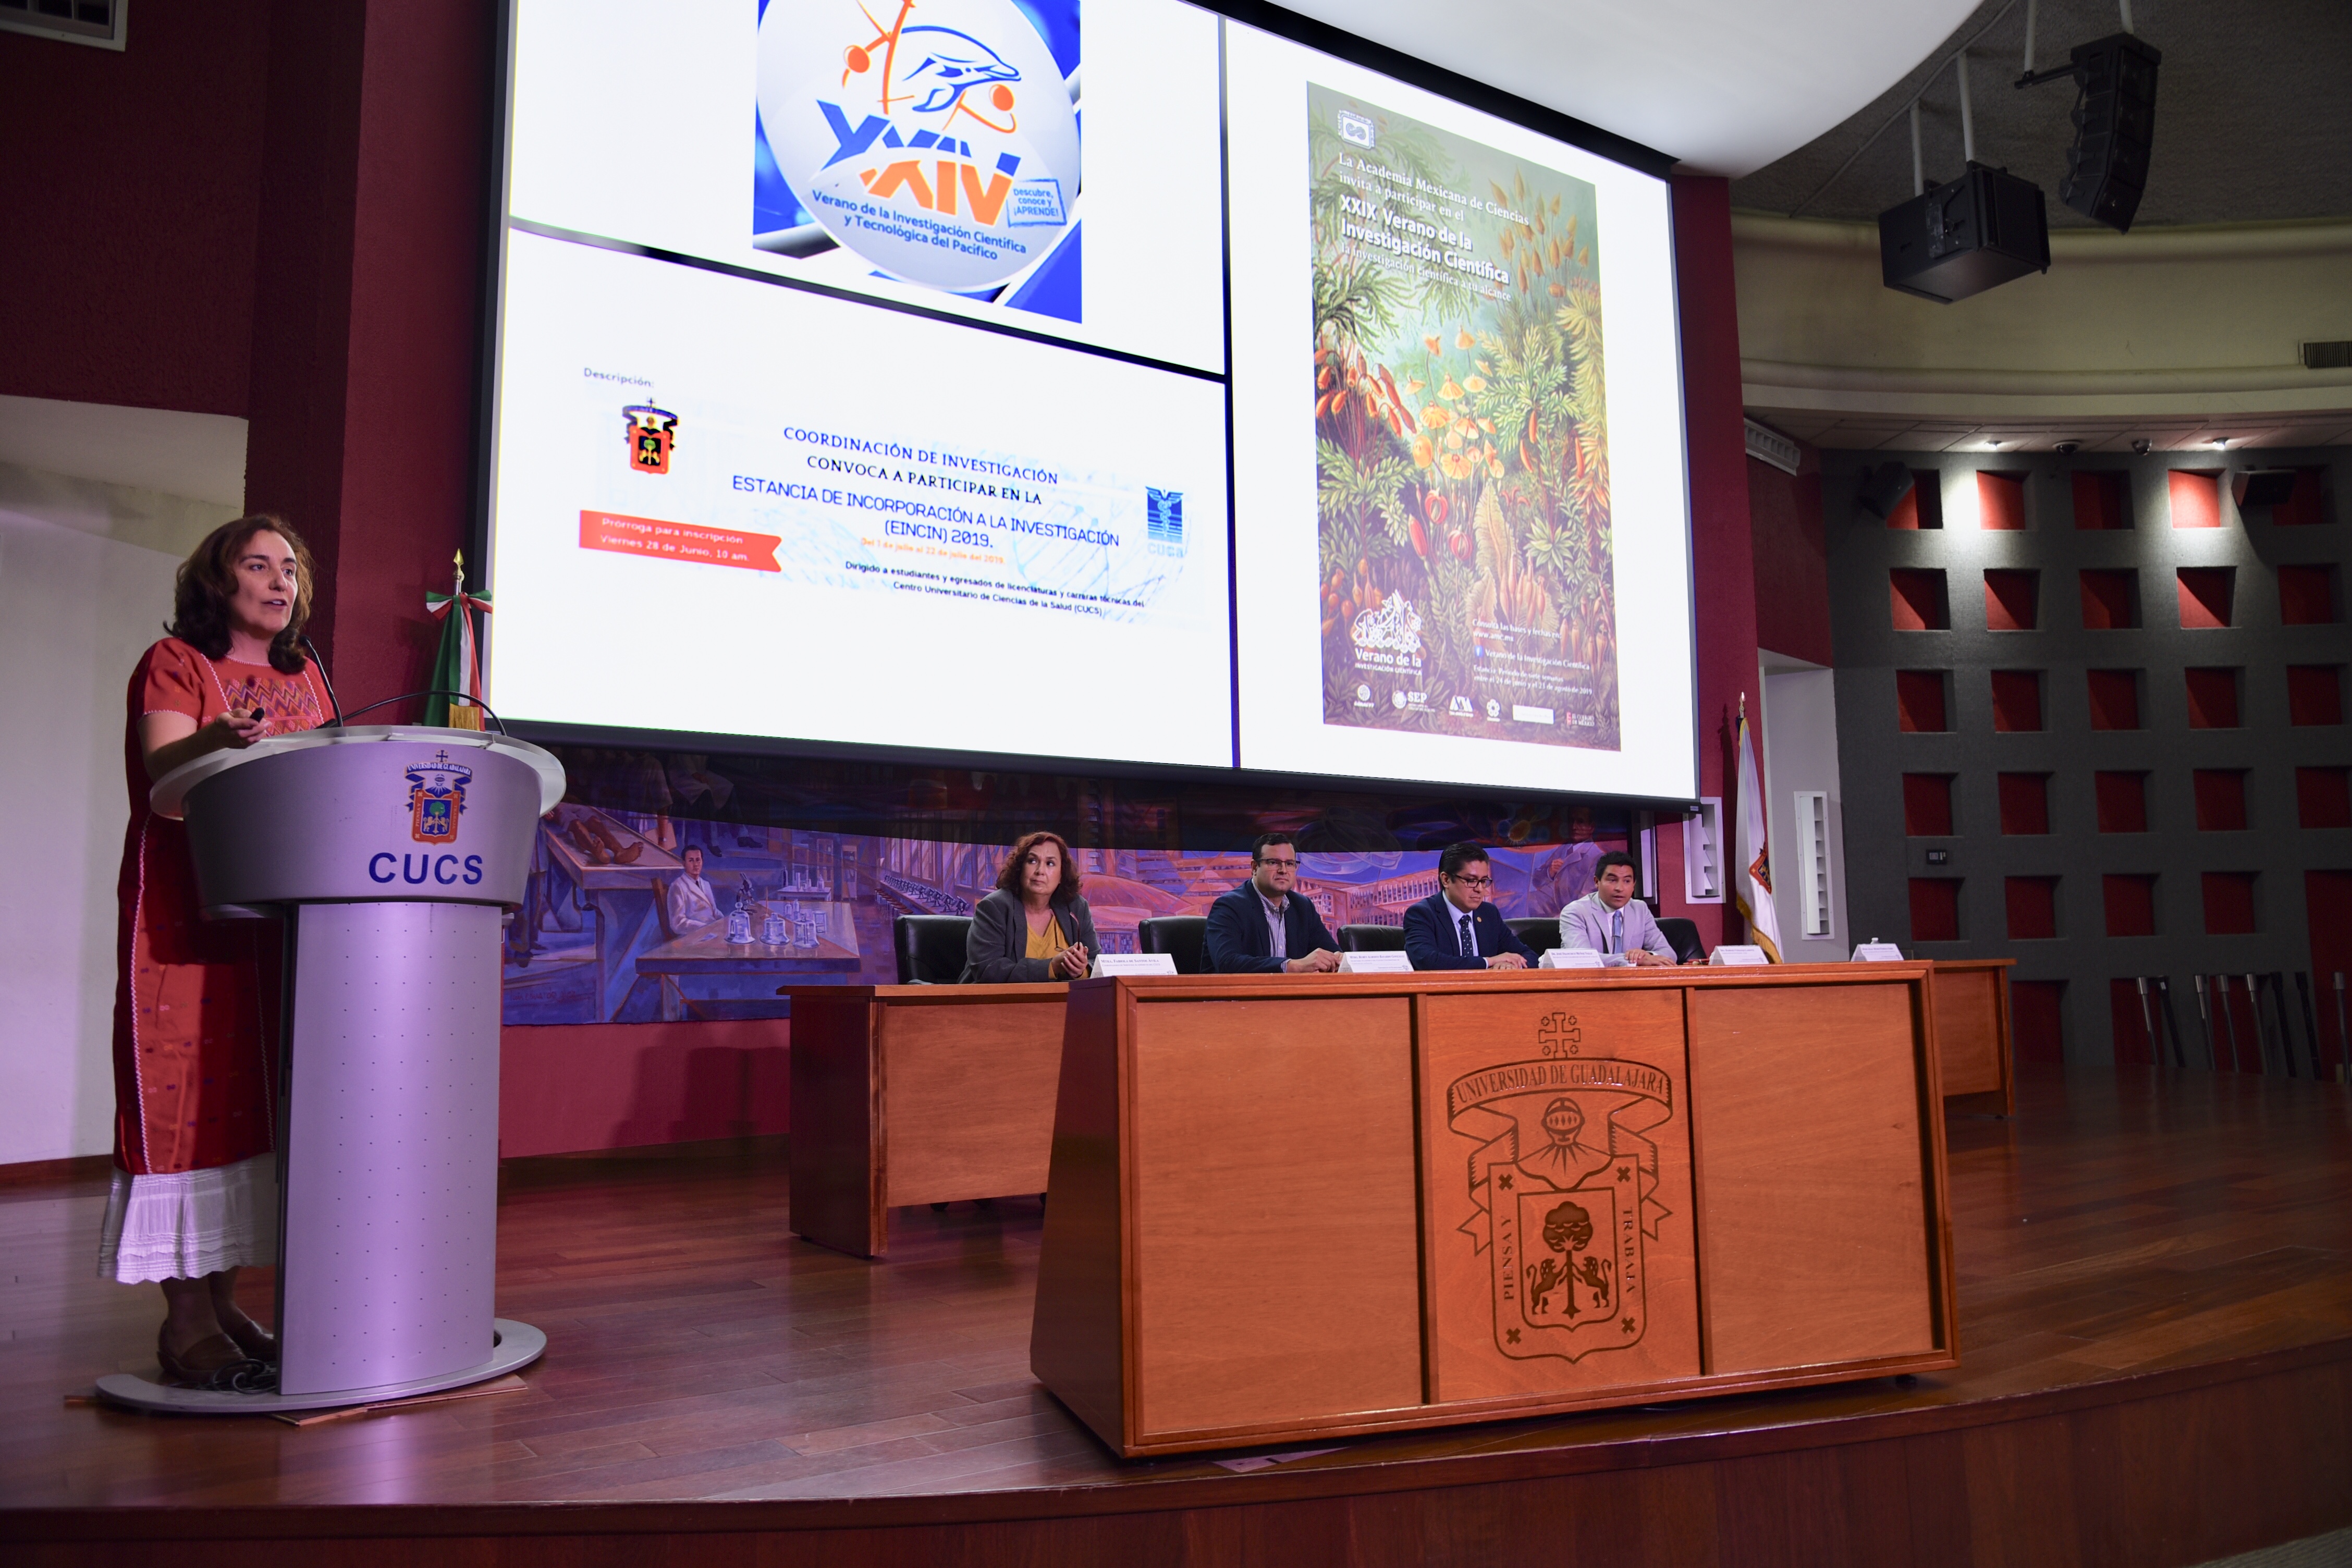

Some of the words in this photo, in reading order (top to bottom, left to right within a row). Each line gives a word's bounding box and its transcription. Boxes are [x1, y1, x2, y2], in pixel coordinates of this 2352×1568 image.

[1013, 189, 1054, 198] Descubre,
[1339, 152, 1353, 168] La
[1357, 159, 1413, 187] Academia
[1416, 178, 1467, 205] Mexicana
[1470, 197, 1483, 210] de
[1486, 201, 1529, 226] Ciencias
[1340, 171, 1372, 191] invita
[1375, 185, 1381, 194] a
[1385, 188, 1437, 212] participar
[1439, 206, 1452, 217] en
[1455, 210, 1464, 221] el
[812, 189, 858, 211] Verano
[861, 203, 876, 215] de
[879, 206, 890, 219] la
[893, 210, 971, 240] Investigación
[974, 231, 1026, 254] Científica
[1014, 206, 1059, 216] ¡APRENDE!
[1340, 194, 1377, 221] XXIX
[1382, 208, 1436, 239] Verano
[1438, 226, 1457, 246] de
[1460, 231, 1472, 251] la
[844, 215, 852, 227] y
[855, 215, 928, 243] Tecnológica
[931, 234, 949, 248] del
[1341, 218, 1441, 263] Investigación
[1444, 250, 1510, 284] Científica
[1341, 242, 1350, 254] la
[1353, 245, 1415, 273] investigación
[1417, 266, 1459, 286] científica
[1468, 281, 1478, 291] tu
[1480, 285, 1512, 302] alcance
[584, 368, 654, 388] Descripción:
[784, 427, 912, 460] COORDINACIÓN
[918, 449, 937, 464] DE
[942, 454, 1058, 484] INVESTIGACIÓN
[807, 456, 888, 480] CONVOCA
[893, 470, 903, 482] A
[908, 472, 997, 497] PARTICIPAR
[1002, 487, 1020, 501] EN
[1025, 491, 1042, 505] LA
[733, 475, 818, 501] ESTANCIA
[823, 489, 843, 505] DE
[847, 493, 973, 524] INCORPORACIÓN
[976, 513, 986, 527] A
[990, 515, 1007, 530] LA
[1011, 518, 1119, 547] INVESTIGACIÓN
[601, 534, 643, 548] Viernes
[646, 541, 659, 550] 28
[662, 543, 676, 552] de
[680, 545, 713, 558] Junio,
[716, 549, 728, 558] 10
[655, 526, 680, 536] para
[683, 529, 743, 544] inscripción
[861, 537, 875, 546] Del
[885, 520, 947, 544] (EINCIN)
[951, 529, 993, 548] 2019.
[846, 561, 880, 573] Dirigido
[891, 567, 940, 581] estudiantes
[950, 575, 993, 587] egresados
[996, 580, 1005, 589] de
[1007, 583, 1057, 596] licenciaturas
[1060, 590, 1064, 598] y
[1067, 592, 1097, 601] carreras
[1133, 598, 1144, 608] del
[893, 581, 922, 592] Centro
[925, 584, 977, 599] Universitario
[981, 591, 990, 600] de
[993, 594, 1027, 606] Ciencias
[1030, 598, 1039, 607] de
[1050, 602, 1072, 611] Salud
[1074, 605, 1102, 617] (CUCS)
[1473, 619, 1499, 630] Consulta
[1500, 622, 1509, 631] las
[1510, 624, 1526, 634] bases
[1355, 647, 1394, 664] Verano
[1396, 653, 1410, 666] de
[1412, 654, 1422, 667] la
[1486, 649, 1506, 659] Verano
[1407, 691, 1428, 703] SEP
[408, 762, 437, 771] UNIVERSIDAD
[369, 852, 483, 885] CUCS
[1455, 1065, 1548, 1104] UNIVERSIDAD
[1550, 1064, 1567, 1084] DE
[1570, 1063, 1663, 1095] GUADALAJARA
[1622, 1206, 1636, 1294] TRABAJA
